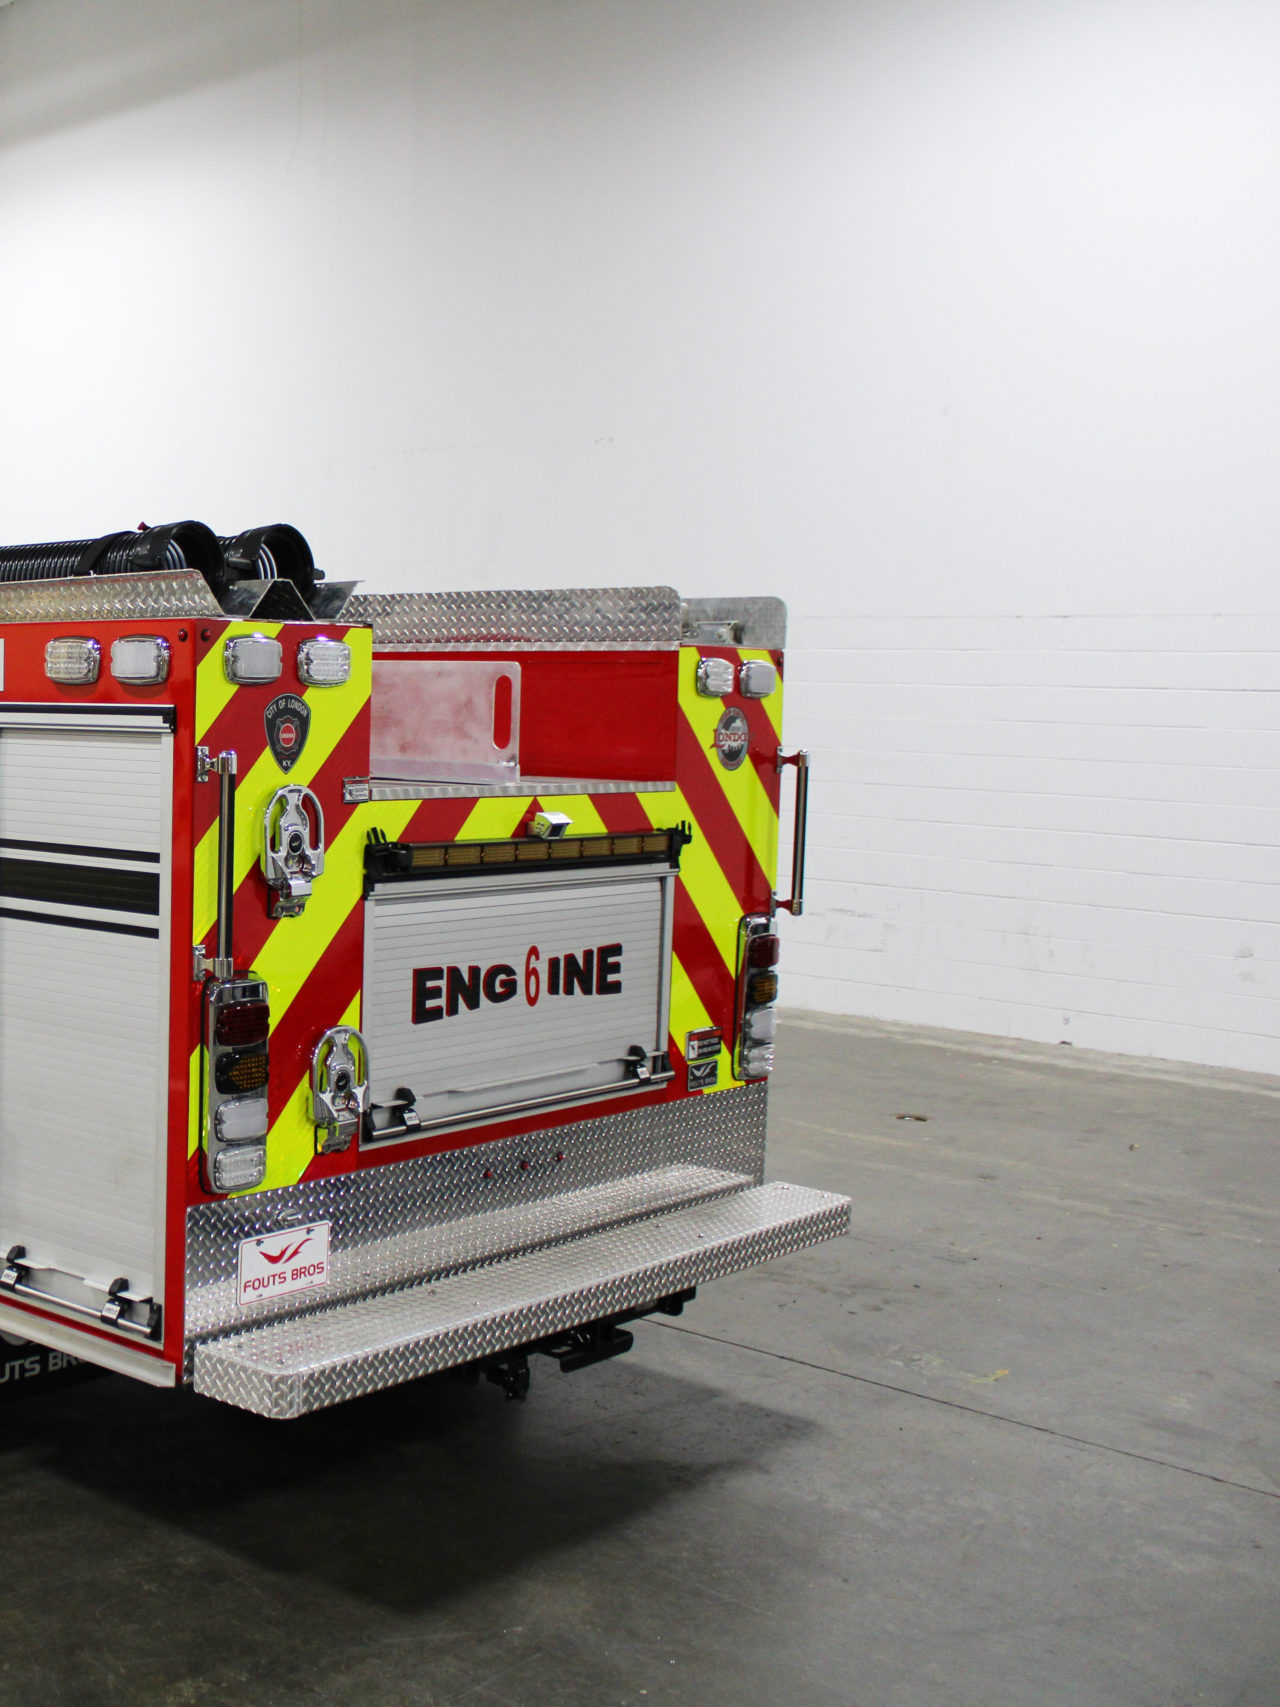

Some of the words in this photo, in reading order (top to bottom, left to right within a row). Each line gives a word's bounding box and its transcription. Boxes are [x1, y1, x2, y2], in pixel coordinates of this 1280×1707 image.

[266, 704, 278, 719] CITY
[278, 699, 287, 710] OF
[288, 699, 308, 718] LONDON
[411, 943, 623, 1025] ENG6INE
[243, 1271, 287, 1293] FOUTS
[291, 1261, 325, 1281] BROS
